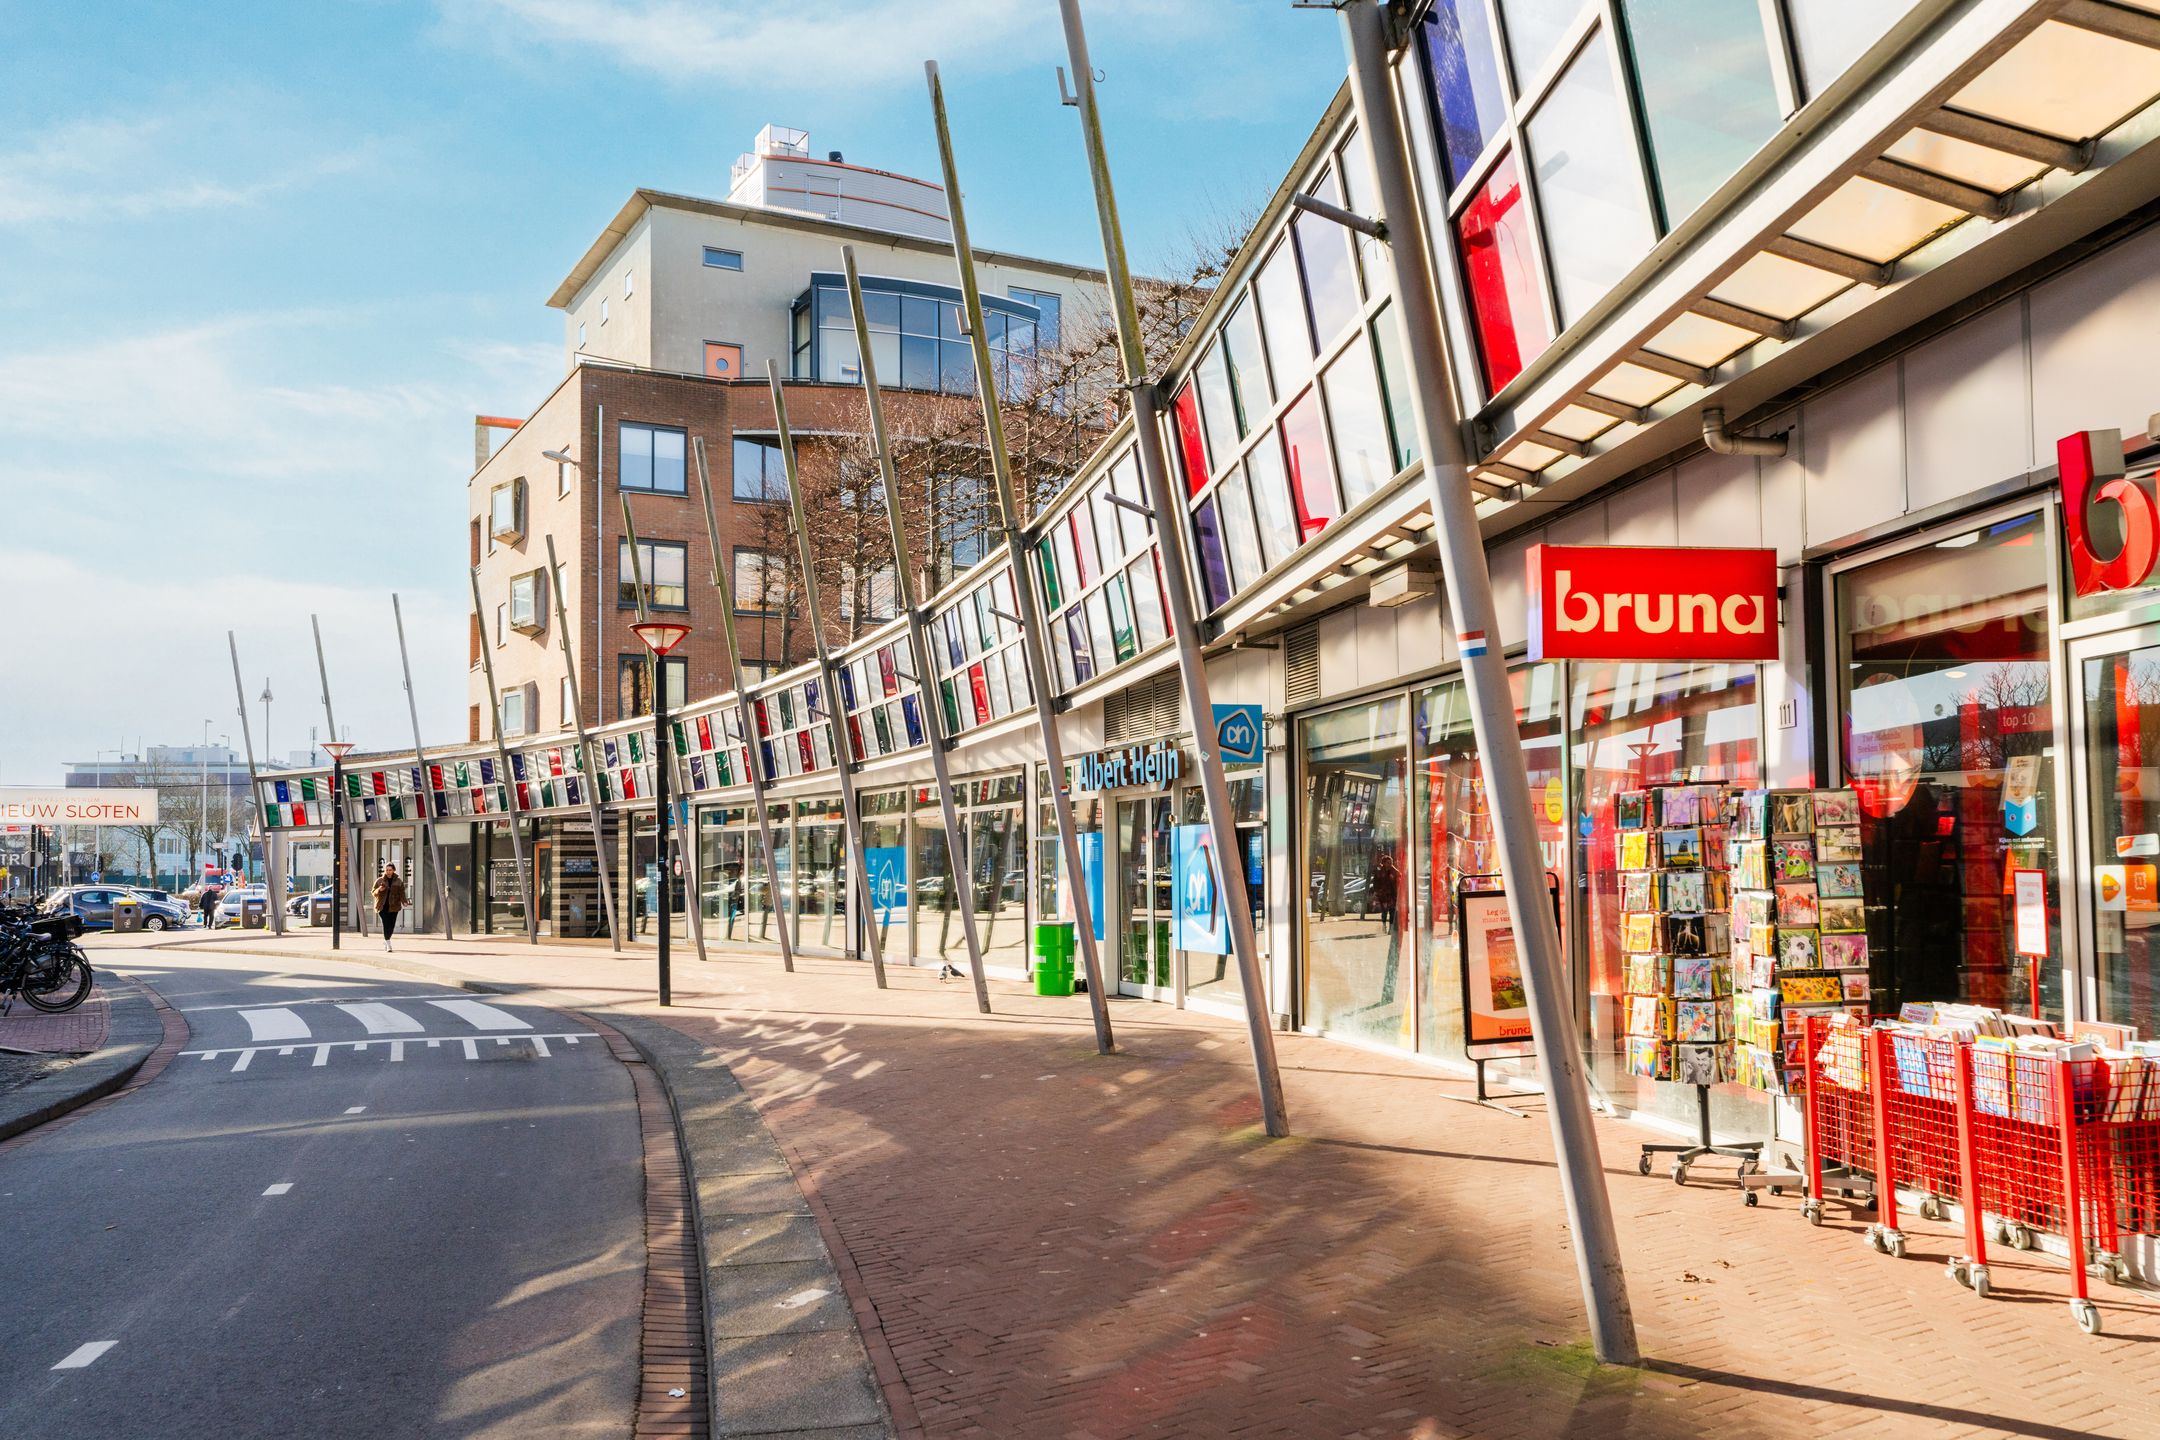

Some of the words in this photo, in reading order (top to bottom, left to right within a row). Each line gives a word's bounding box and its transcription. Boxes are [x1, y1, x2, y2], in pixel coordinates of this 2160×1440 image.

[2057, 431, 2160, 598] b
[1555, 569, 1765, 635] bruna
[2002, 714, 2019, 728] top
[2021, 712, 2036, 726] 10
[1078, 750, 1128, 791] Albert
[1131, 741, 1179, 791] Heijn
[66, 804, 140, 819] SLOTEN
